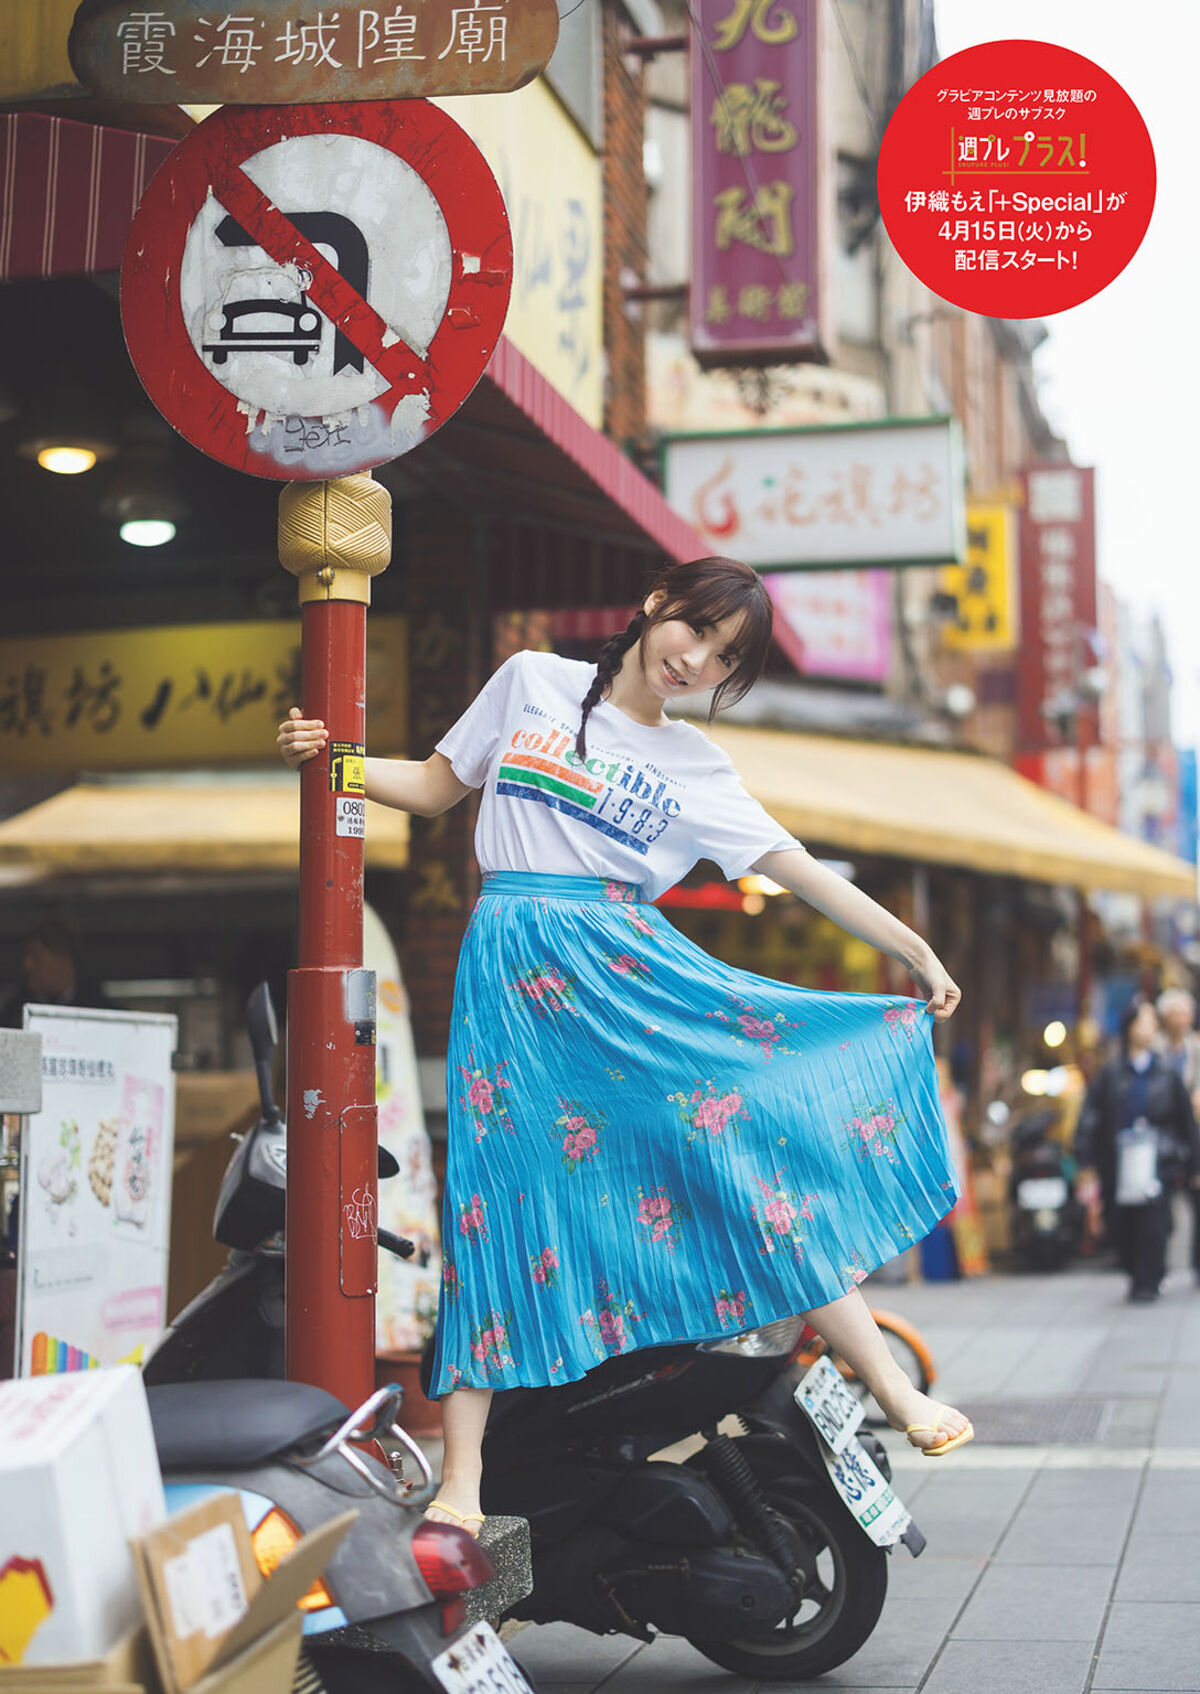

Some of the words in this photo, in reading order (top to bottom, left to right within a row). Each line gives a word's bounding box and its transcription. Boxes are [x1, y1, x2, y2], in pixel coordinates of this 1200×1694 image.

[116, 0, 508, 75] 霞海城隍廟
[511, 729, 681, 818] collectible
